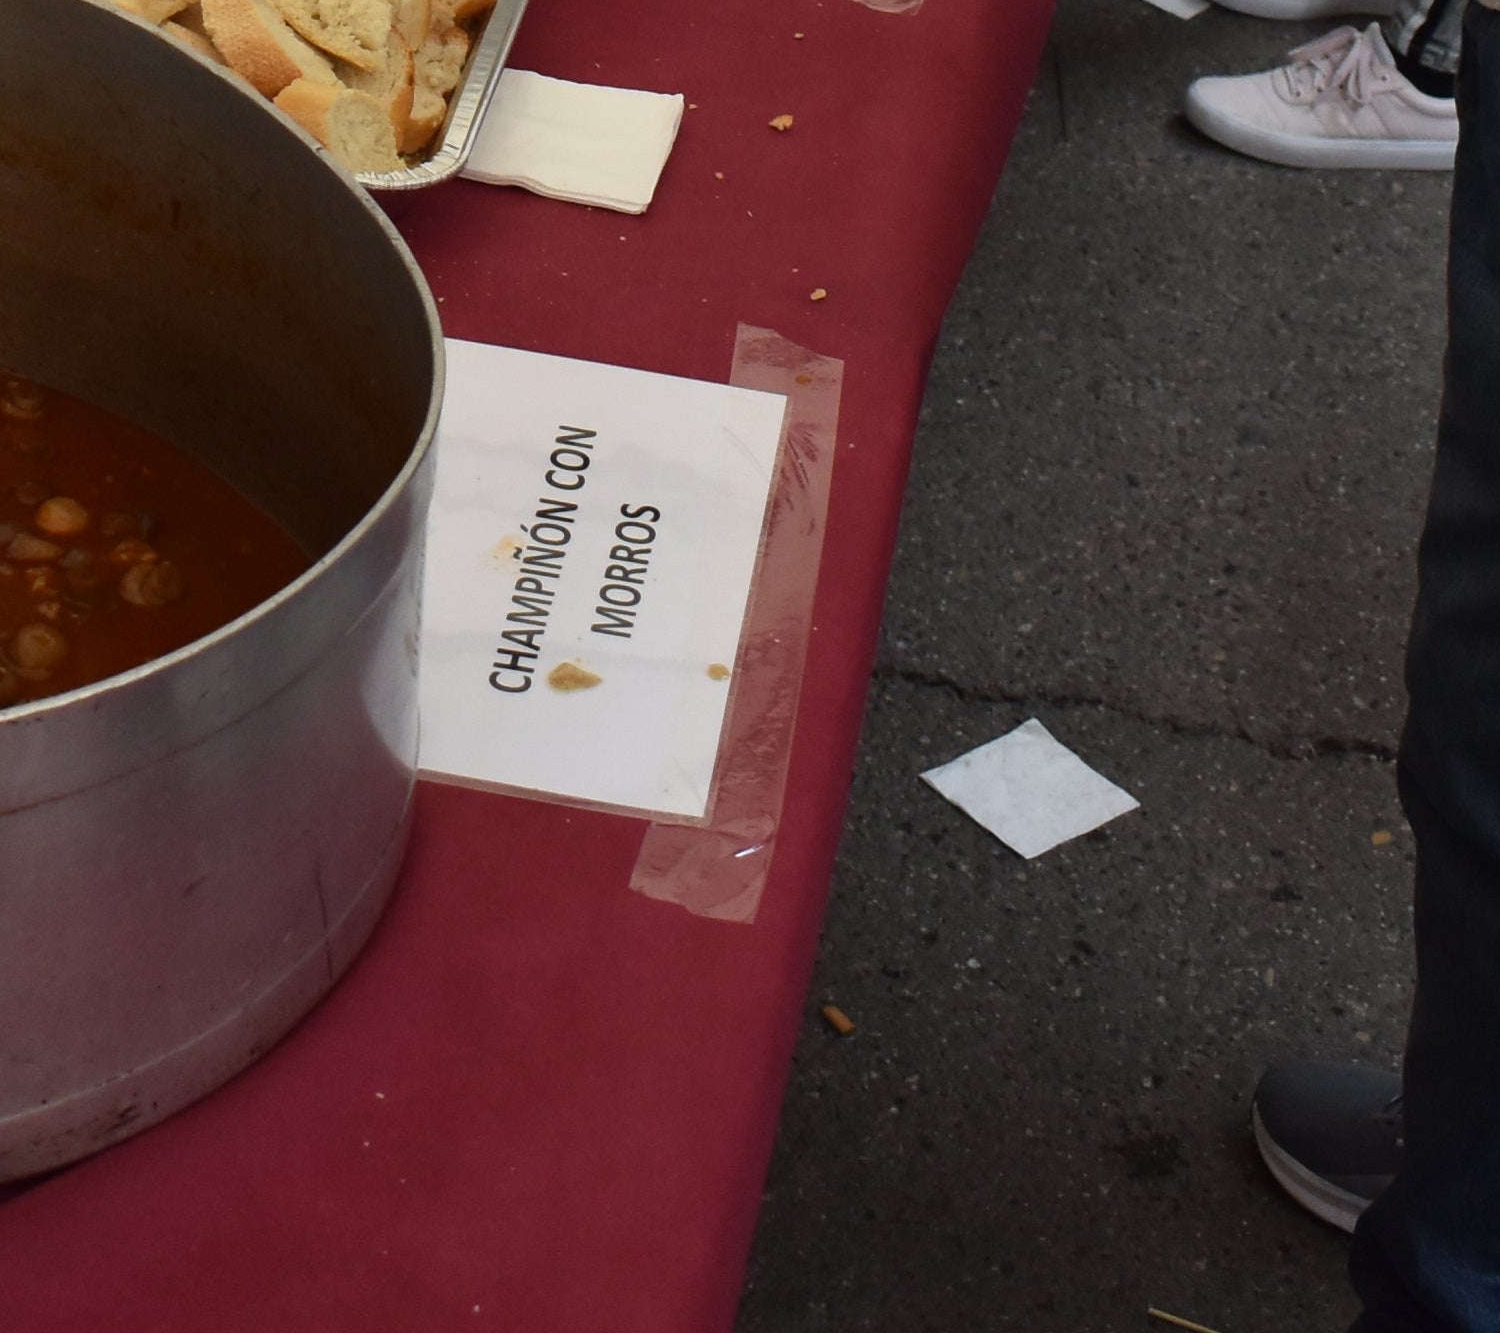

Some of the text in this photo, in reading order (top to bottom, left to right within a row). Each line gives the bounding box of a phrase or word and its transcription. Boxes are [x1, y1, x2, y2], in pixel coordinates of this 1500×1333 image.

[488, 424, 598, 694] CHAMPIÑÓN CON
[590, 503, 661, 639] MORROS
